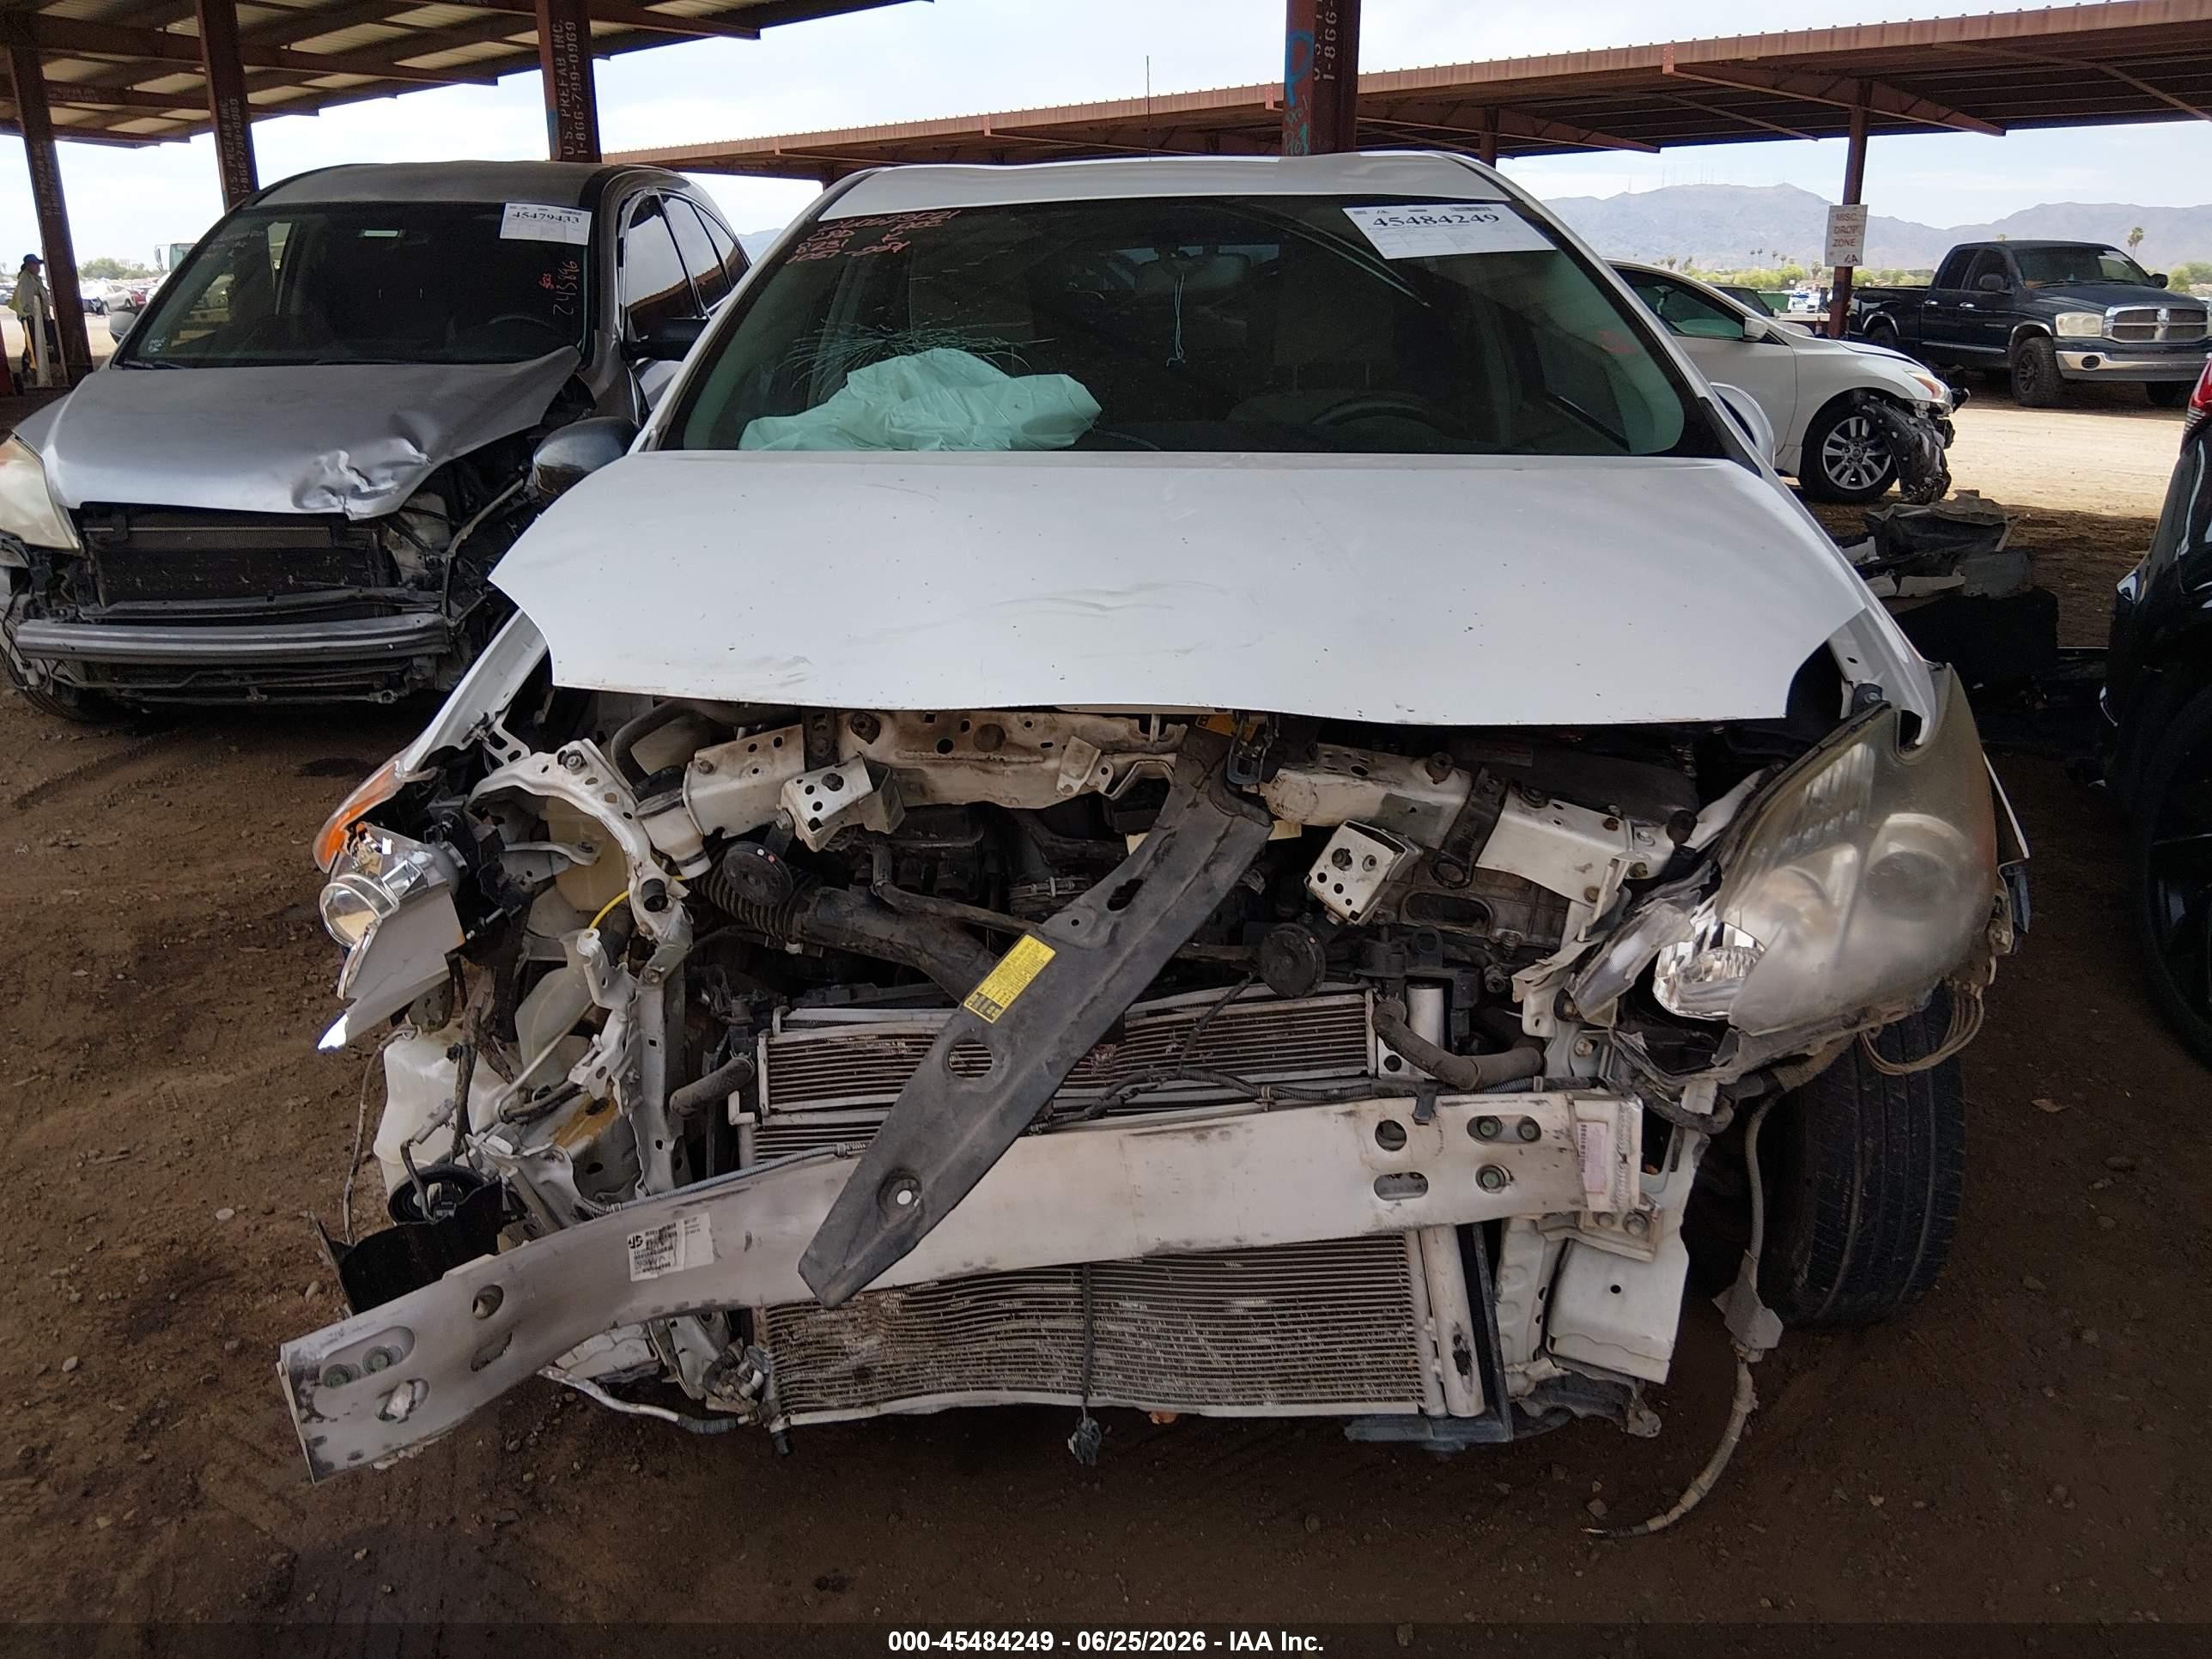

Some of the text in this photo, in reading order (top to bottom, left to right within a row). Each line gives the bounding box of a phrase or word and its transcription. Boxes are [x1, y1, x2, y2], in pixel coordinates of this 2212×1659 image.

[556, 58, 571, 118] PREFAB
[565, 21, 588, 155] 1-866-799-0969
[513, 211, 580, 223] 45479433
[1374, 214, 1499, 228] 45484249
[1832, 238, 1856, 247] ZONE
